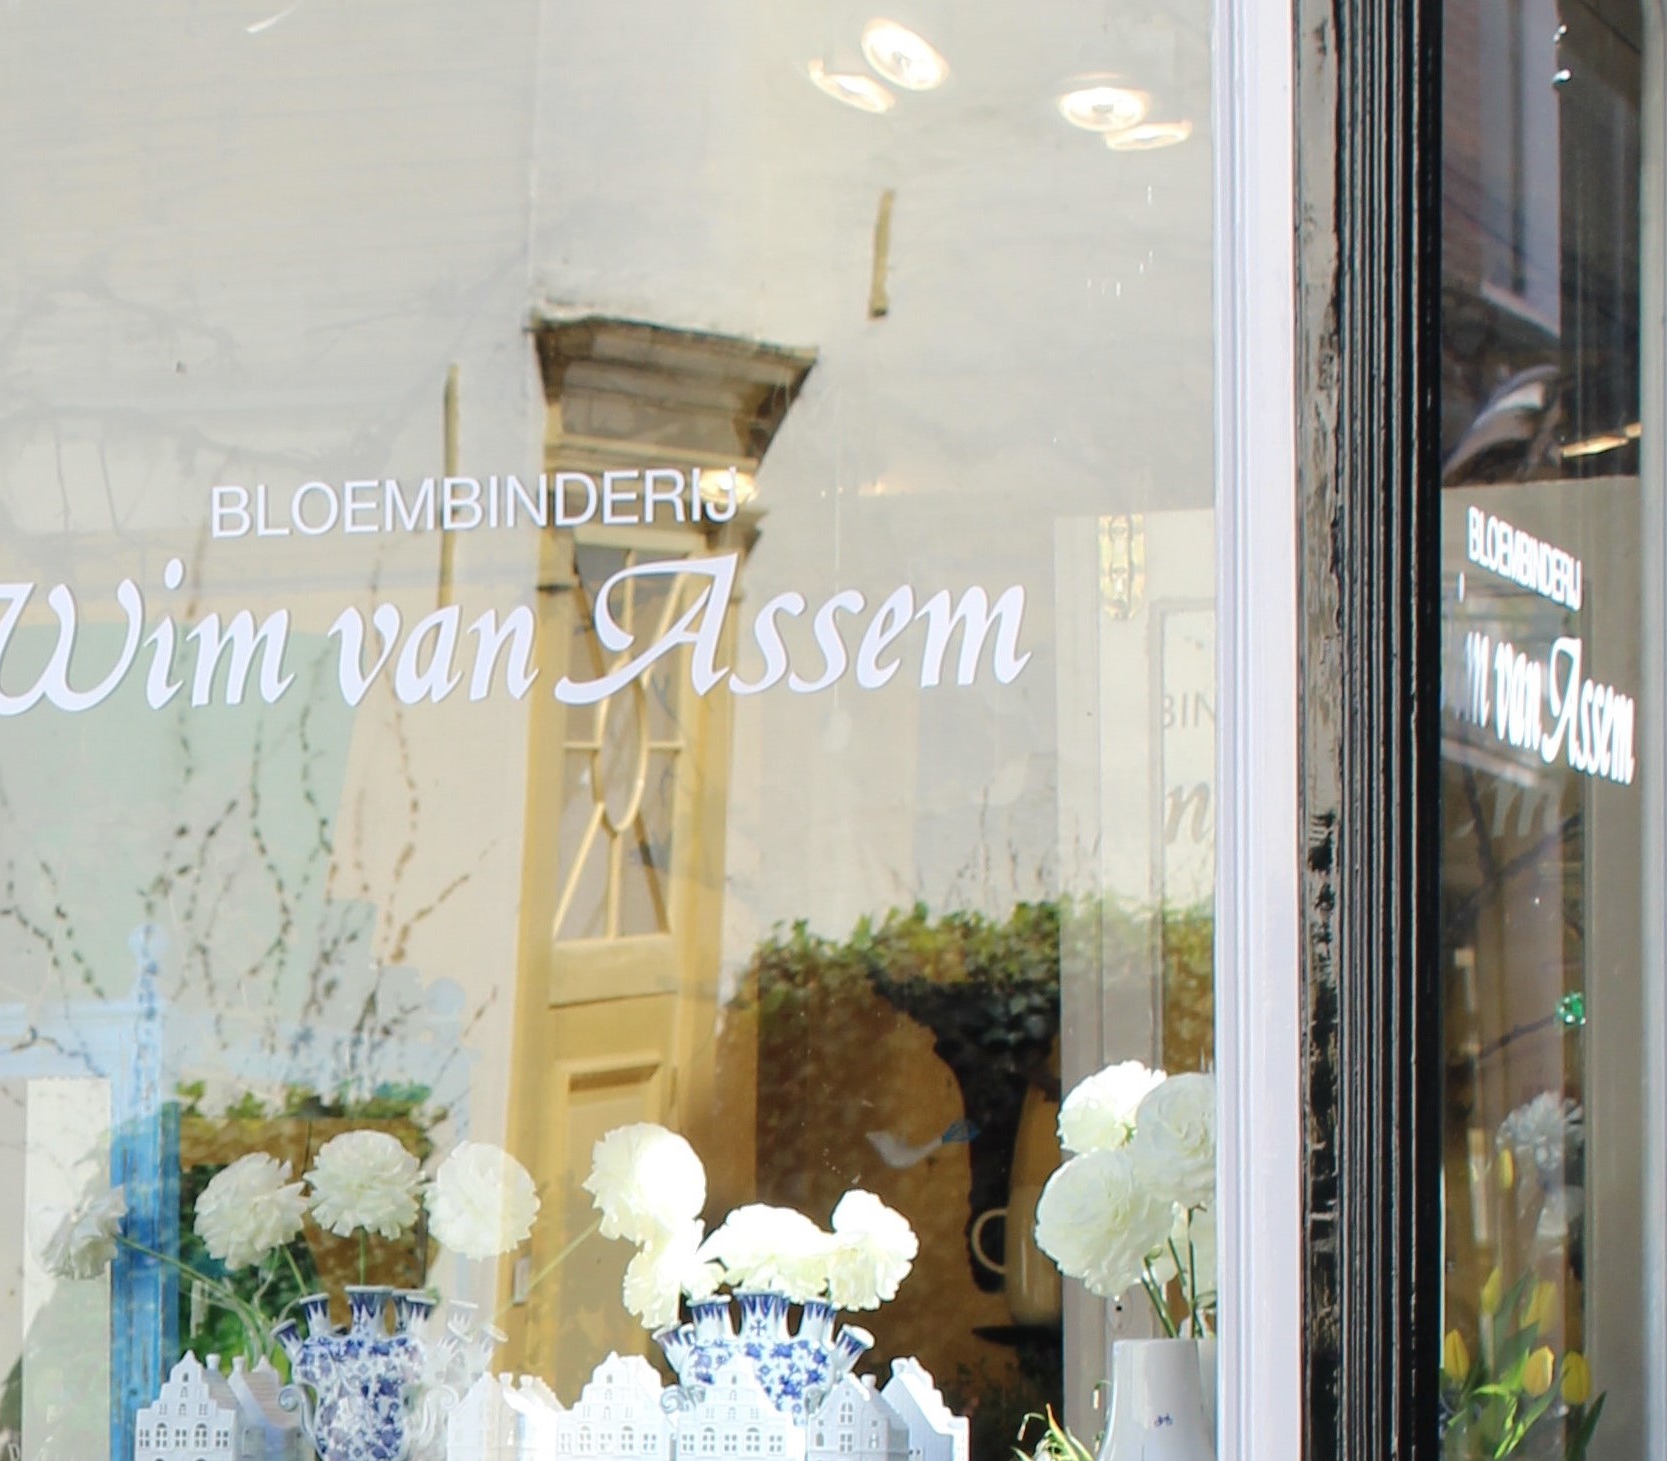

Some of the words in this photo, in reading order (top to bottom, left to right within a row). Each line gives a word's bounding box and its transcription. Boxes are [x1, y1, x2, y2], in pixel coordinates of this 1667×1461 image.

[210, 465, 738, 539] BLOEMBINDERIJ
[1467, 505, 1583, 613] BLOEMBINDERIJ
[326, 602, 540, 707] van
[553, 552, 1032, 705] Assem
[1494, 641, 1541, 751] van
[1541, 635, 1635, 786] Assem
